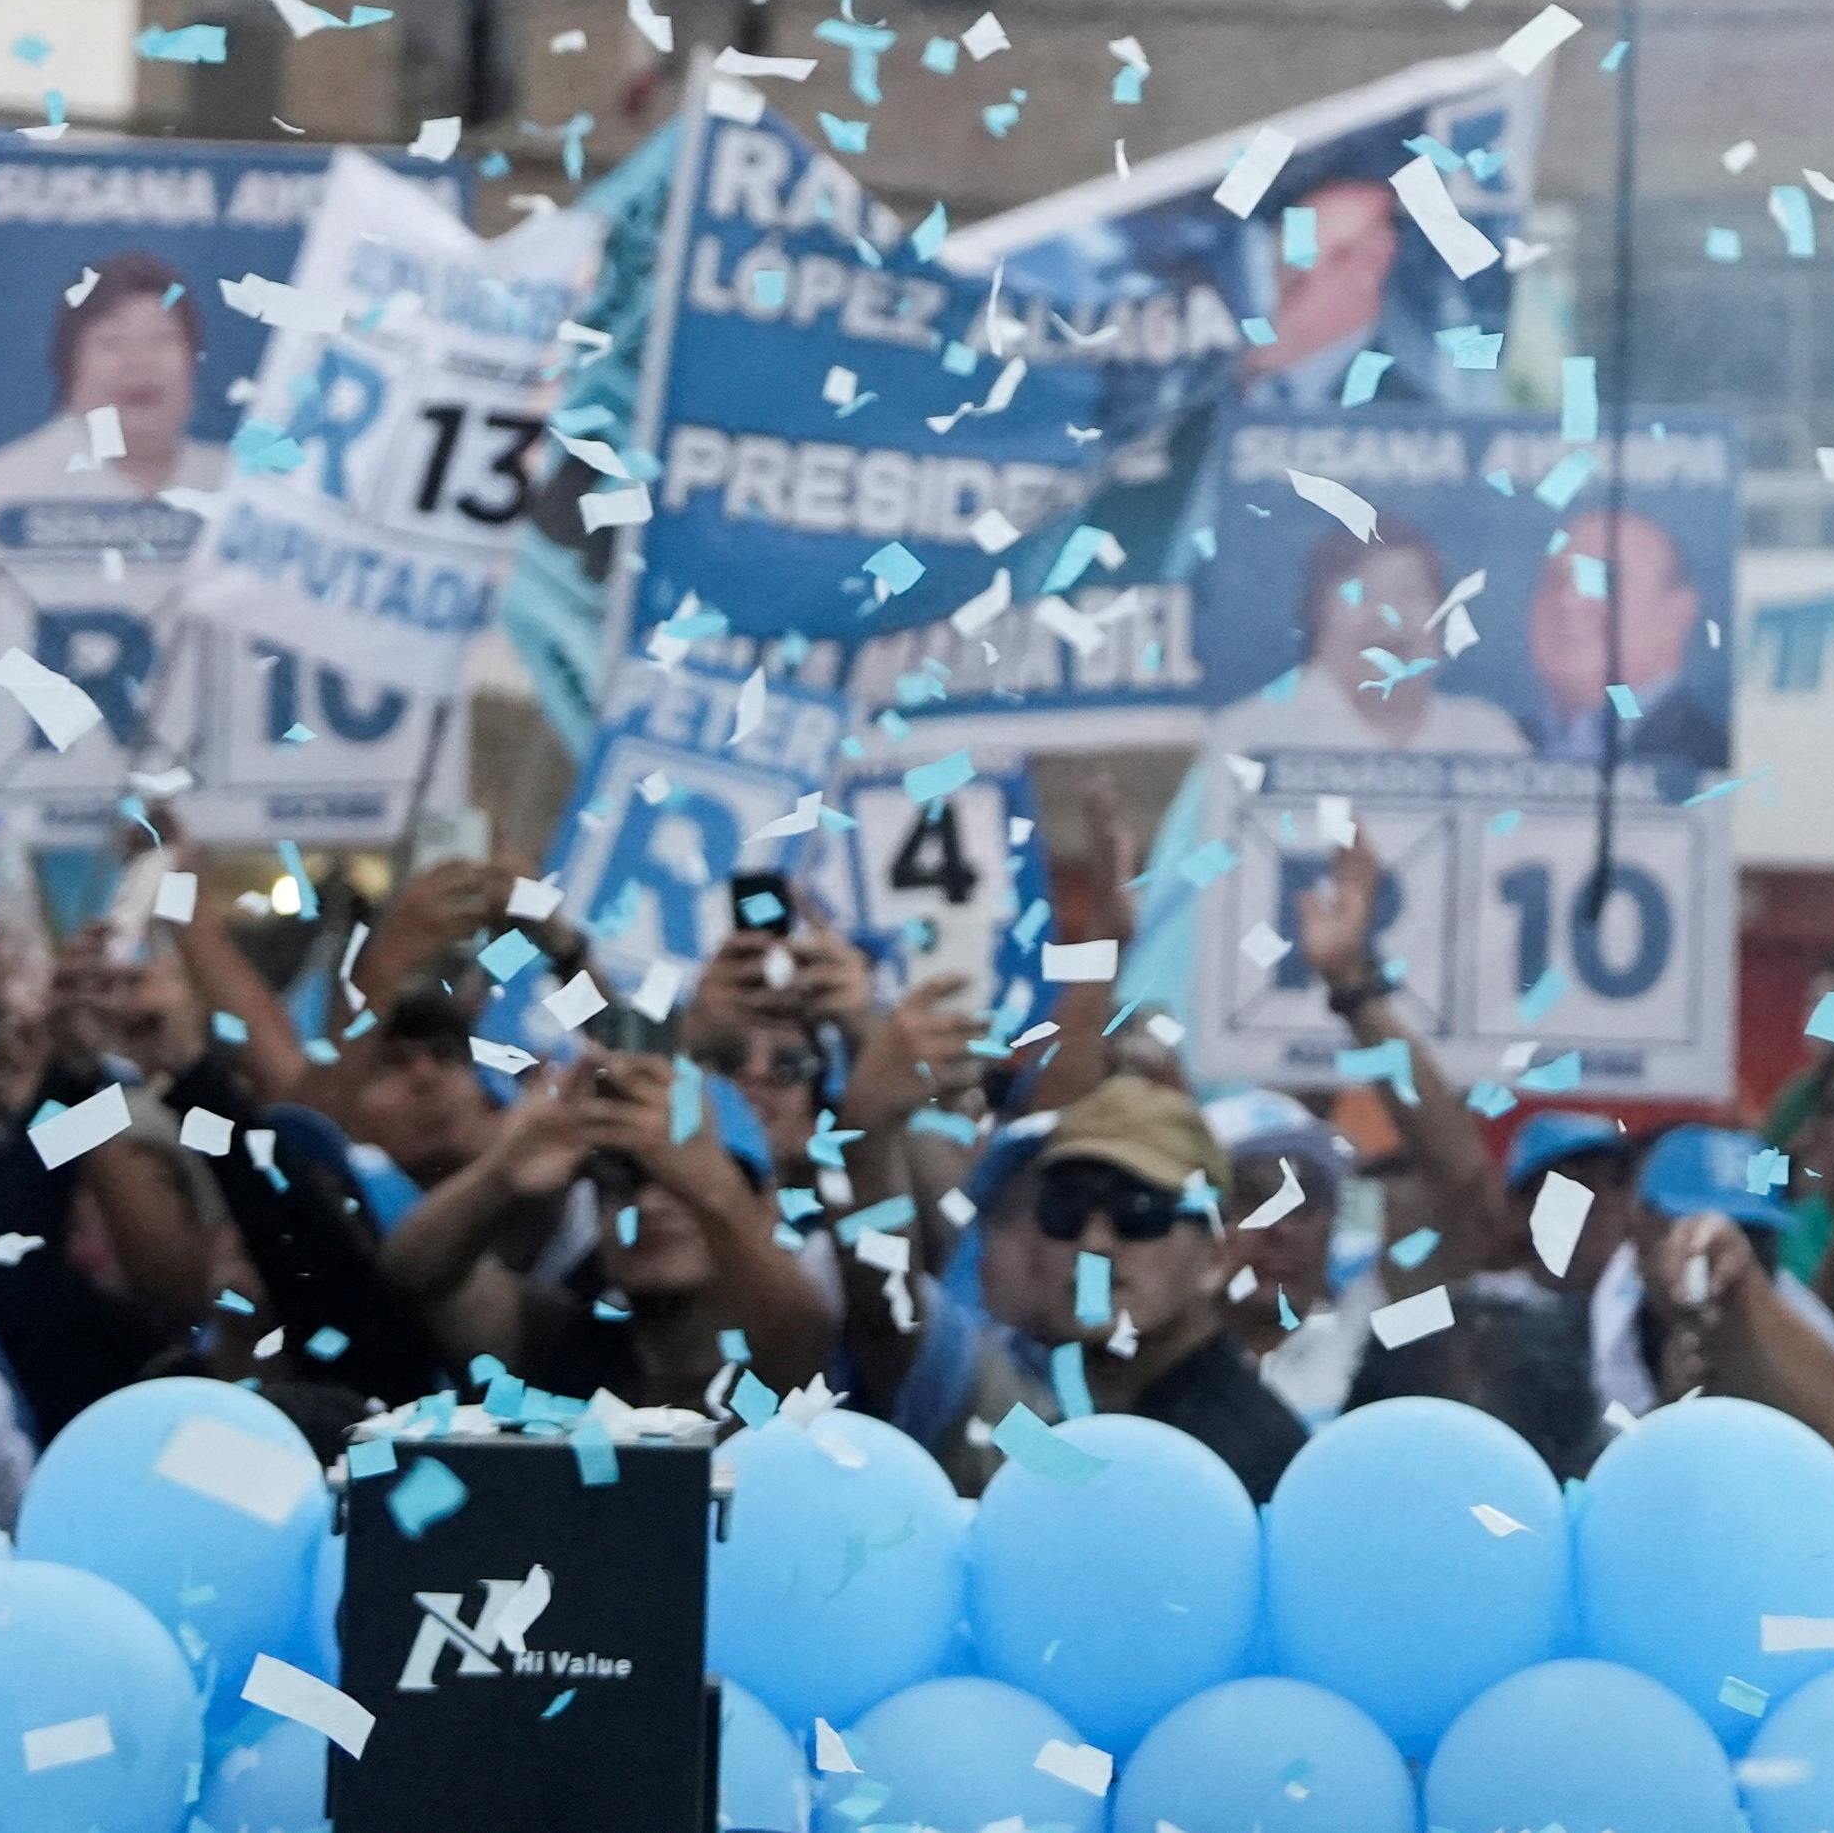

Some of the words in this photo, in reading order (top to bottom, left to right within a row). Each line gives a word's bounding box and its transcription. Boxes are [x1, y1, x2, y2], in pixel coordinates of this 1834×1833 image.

[411, 401, 549, 525] 13
[891, 799, 981, 905] 4
[1499, 861, 1673, 1001] 10
[513, 1651, 545, 1675] Hi
[548, 1651, 633, 1679] Value
